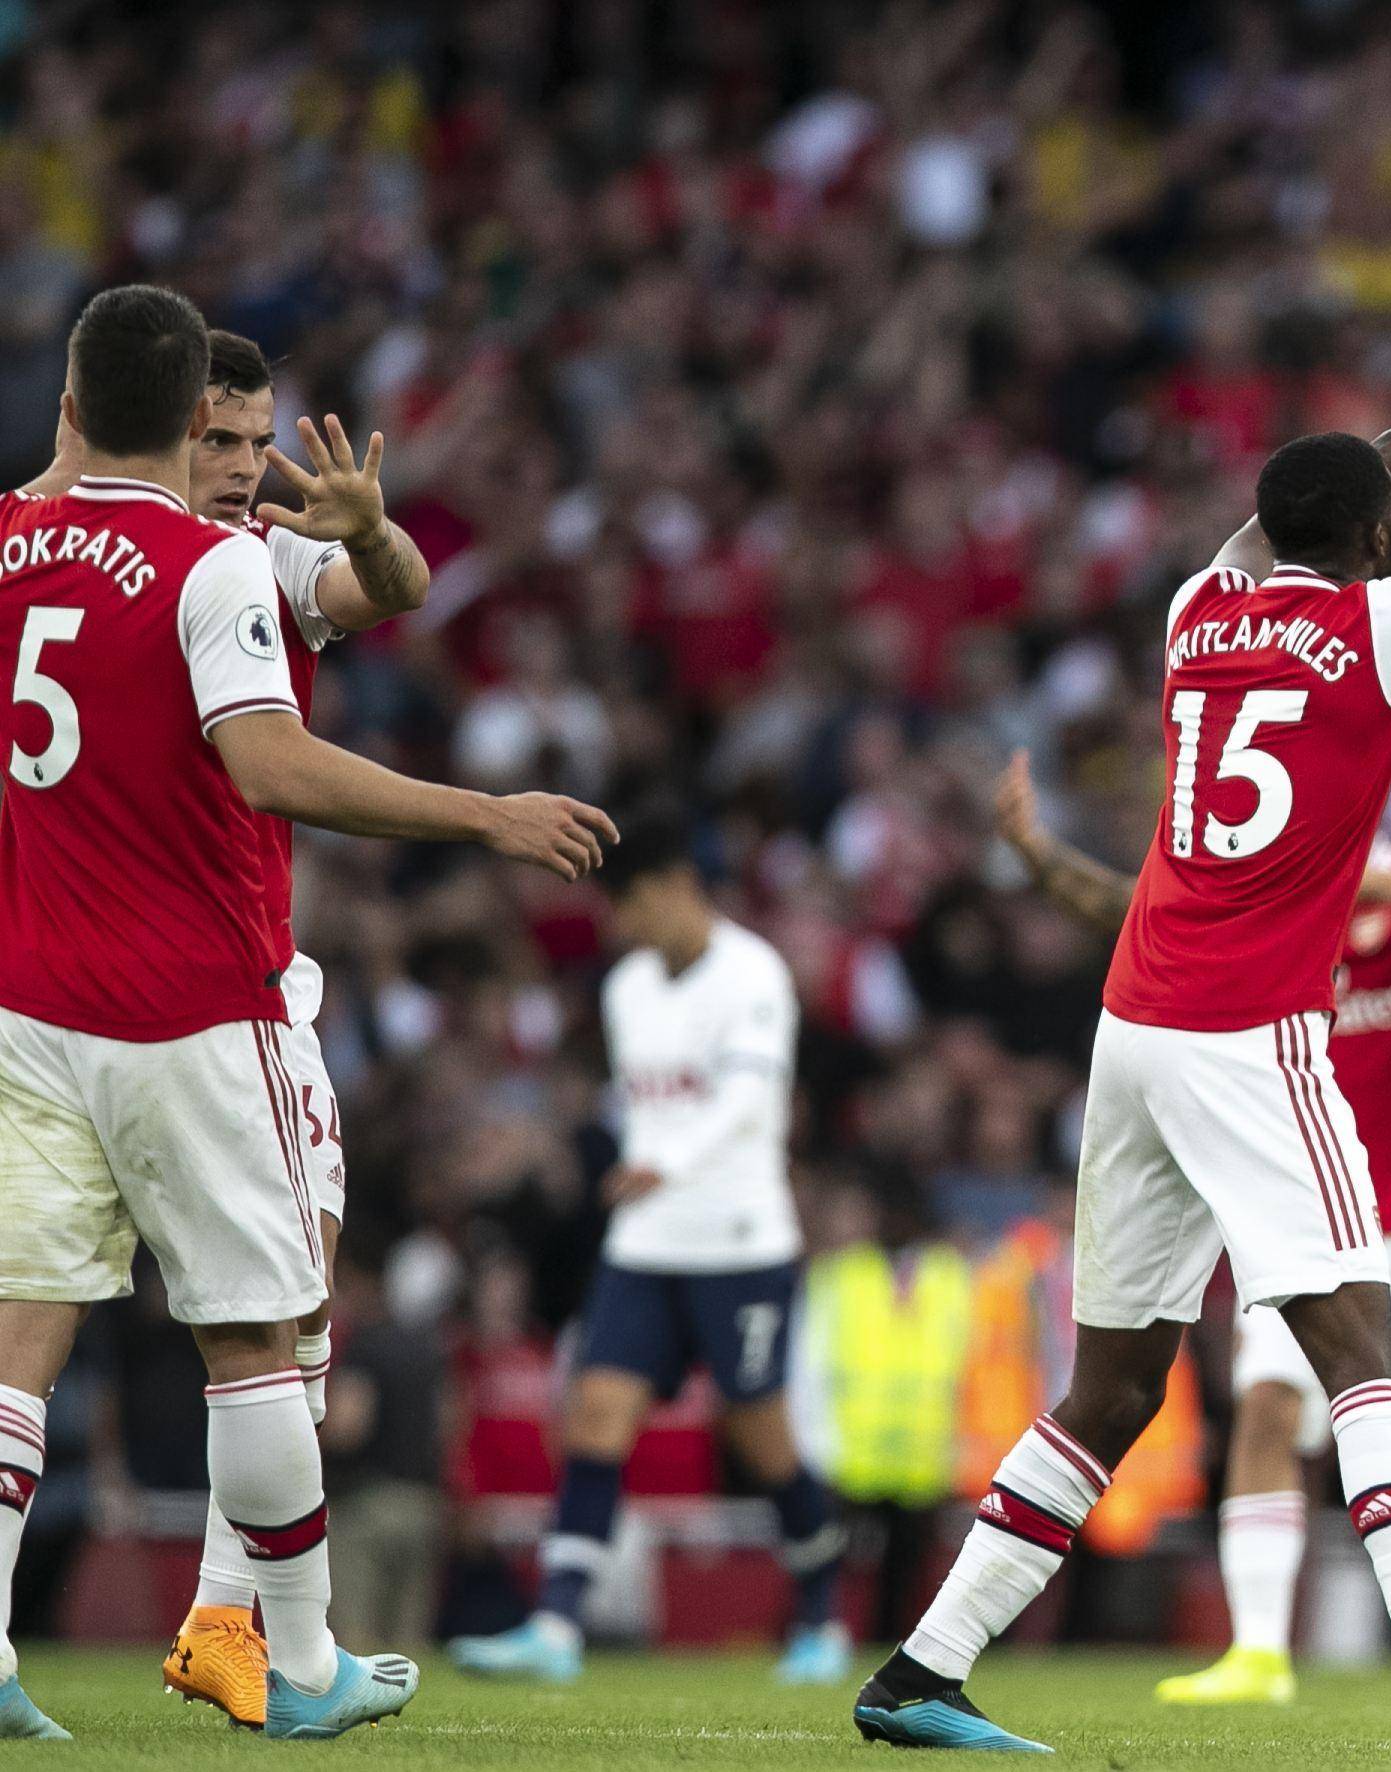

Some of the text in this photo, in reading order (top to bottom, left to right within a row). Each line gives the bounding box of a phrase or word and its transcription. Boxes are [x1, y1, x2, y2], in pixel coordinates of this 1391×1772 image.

[0, 525, 156, 597] OKRATIS
[9, 605, 85, 789] 5
[1171, 690, 1309, 858] 15
